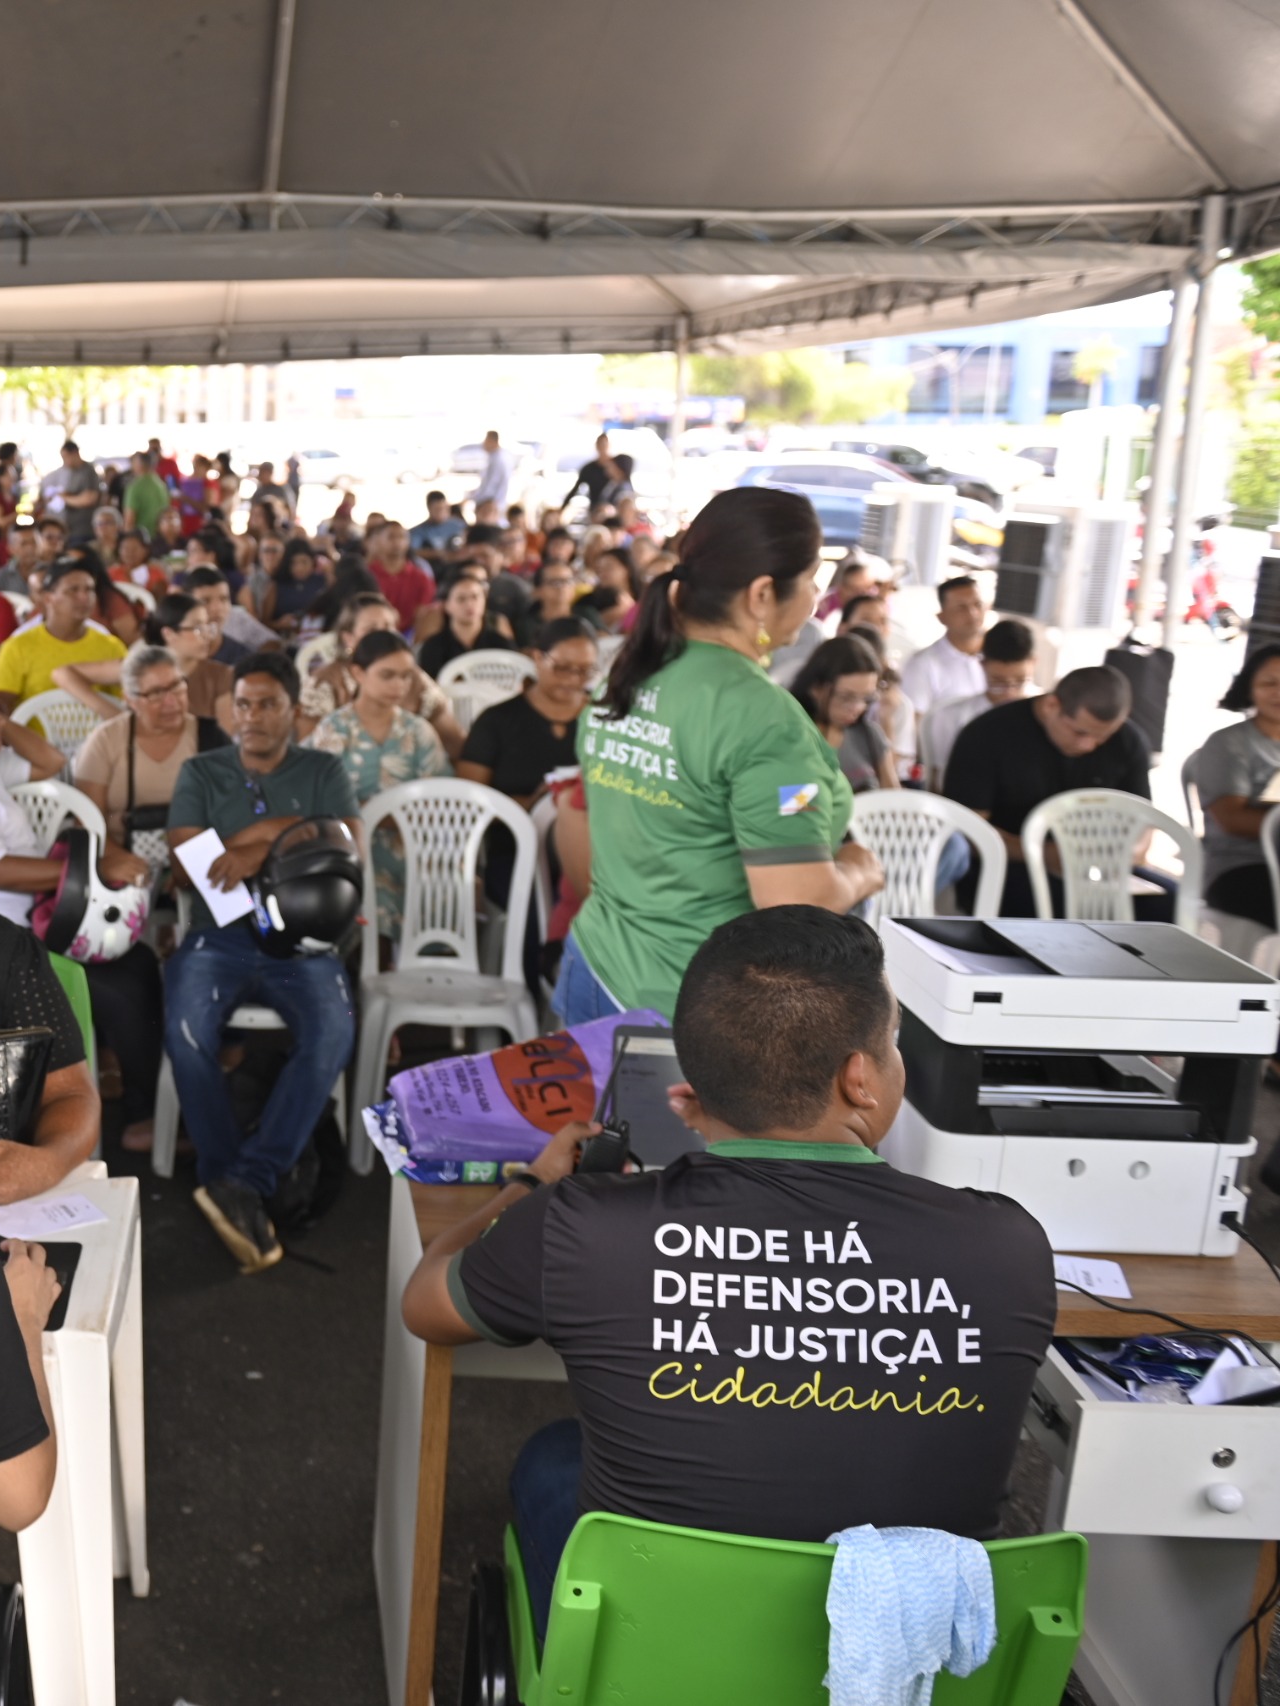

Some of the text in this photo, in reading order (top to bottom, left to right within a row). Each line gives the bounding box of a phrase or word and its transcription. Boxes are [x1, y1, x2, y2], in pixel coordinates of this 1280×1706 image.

[665, 758, 679, 781] E
[653, 1221, 872, 1264] ONDE HÁ
[653, 1269, 971, 1320] DEFENSORIA,
[653, 1312, 981, 1375] HÁ JUSTIÇA E
[648, 1361, 985, 1415] Cidadania.
